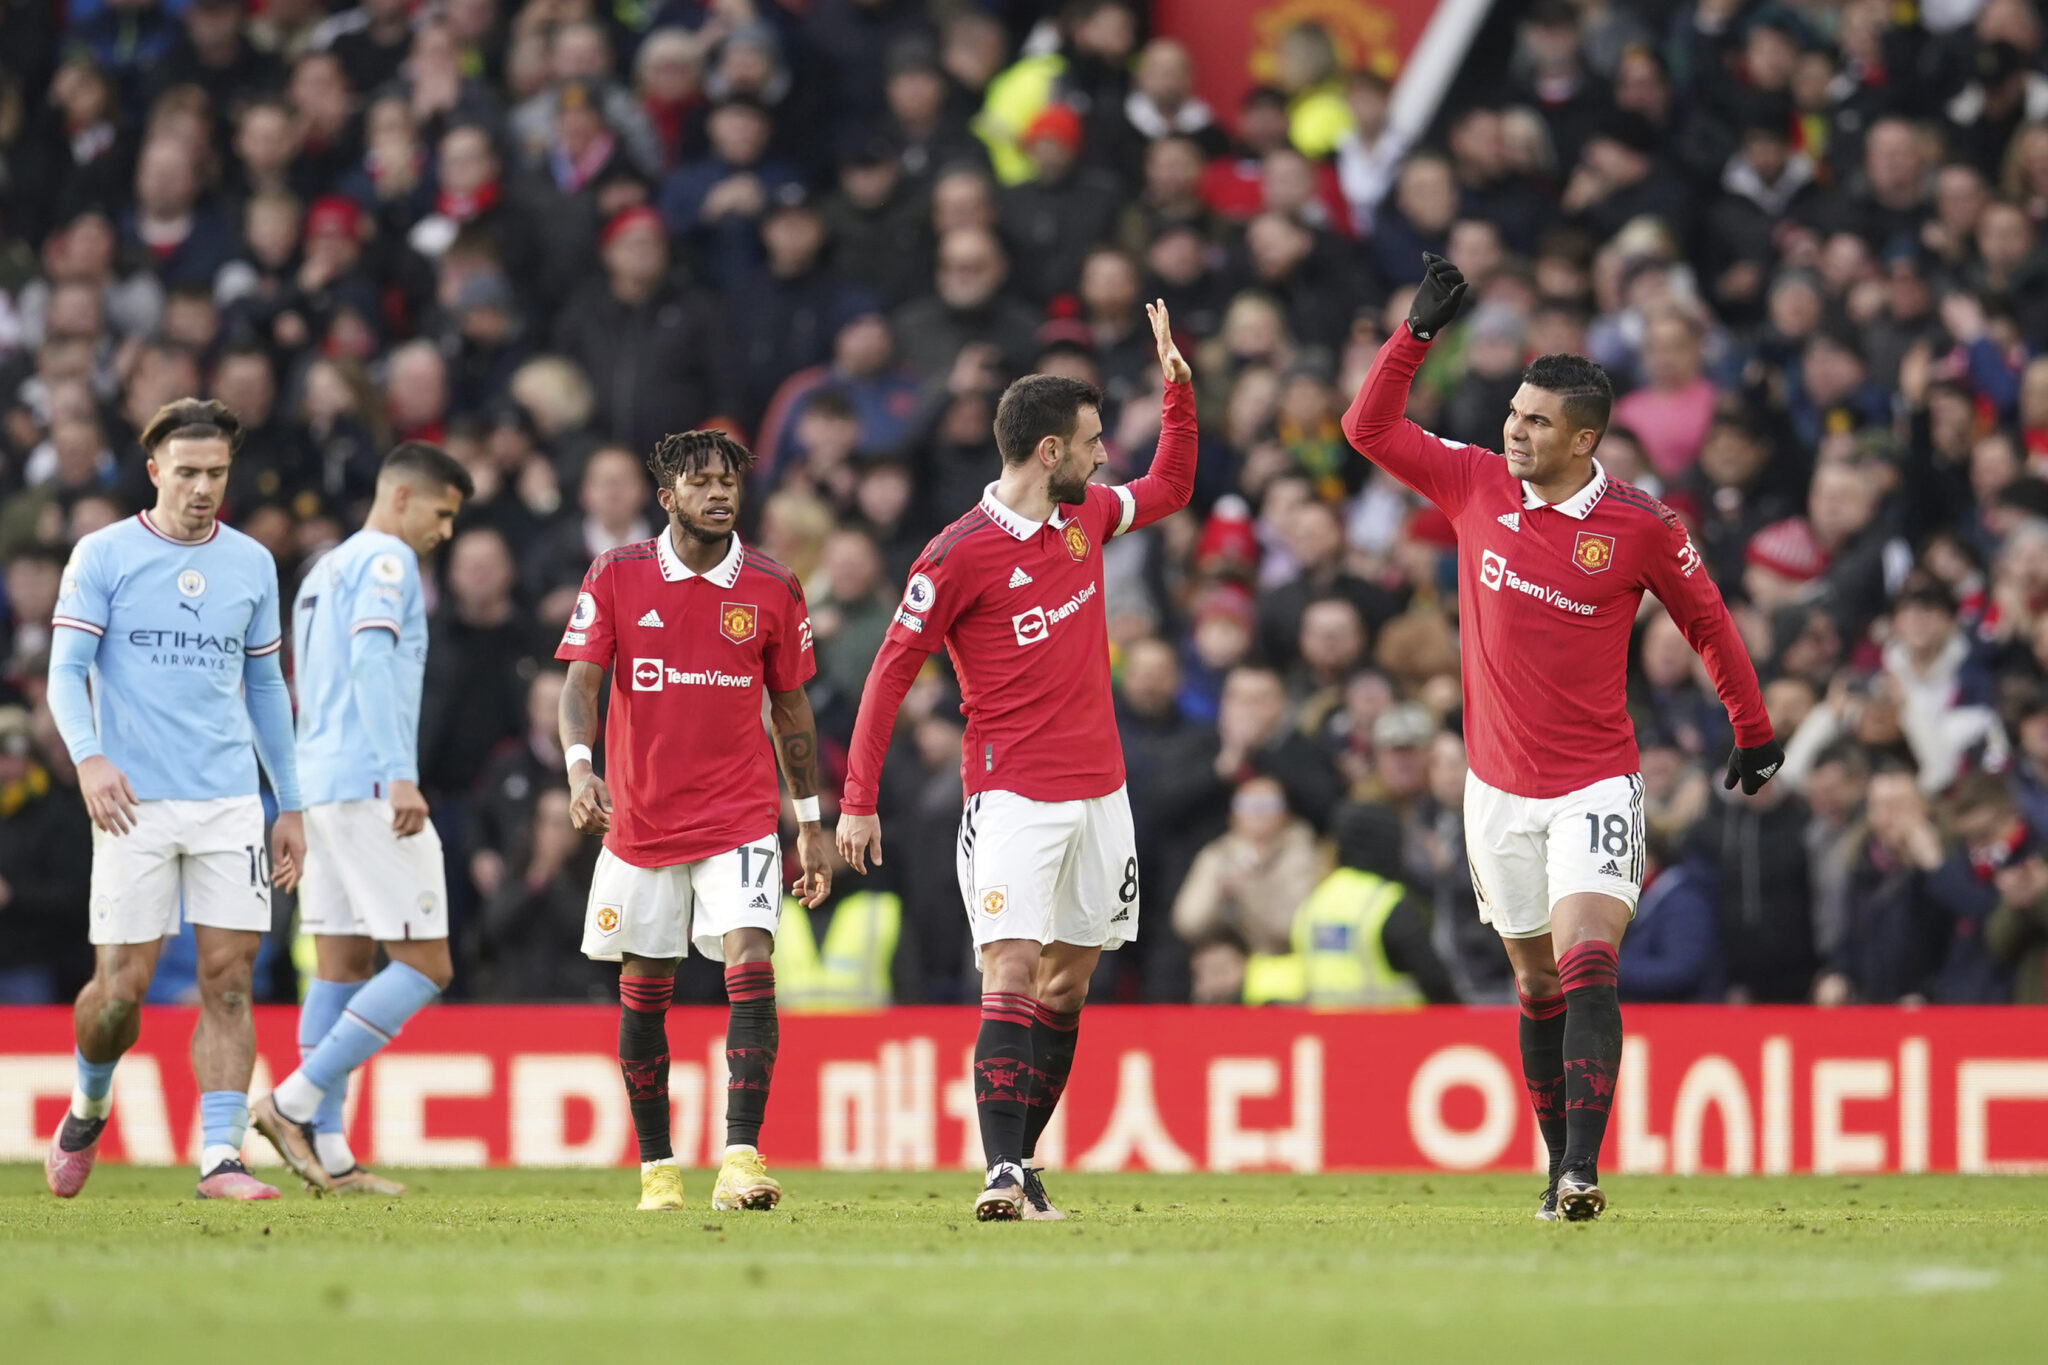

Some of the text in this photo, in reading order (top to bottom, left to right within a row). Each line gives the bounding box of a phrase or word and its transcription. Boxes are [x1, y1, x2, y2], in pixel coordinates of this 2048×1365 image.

[1505, 570, 1597, 616] TeamViewer
[637, 620, 664, 628] adidas
[129, 629, 238, 655] ETIHAD
[151, 653, 225, 670] AIRWAYS
[664, 667, 753, 687] TeamViewer
[1585, 812, 1629, 857] 18
[246, 845, 270, 888] 10
[737, 846, 774, 888] 17
[1119, 856, 1137, 903] 8
[1599, 868, 1622, 878] adidas
